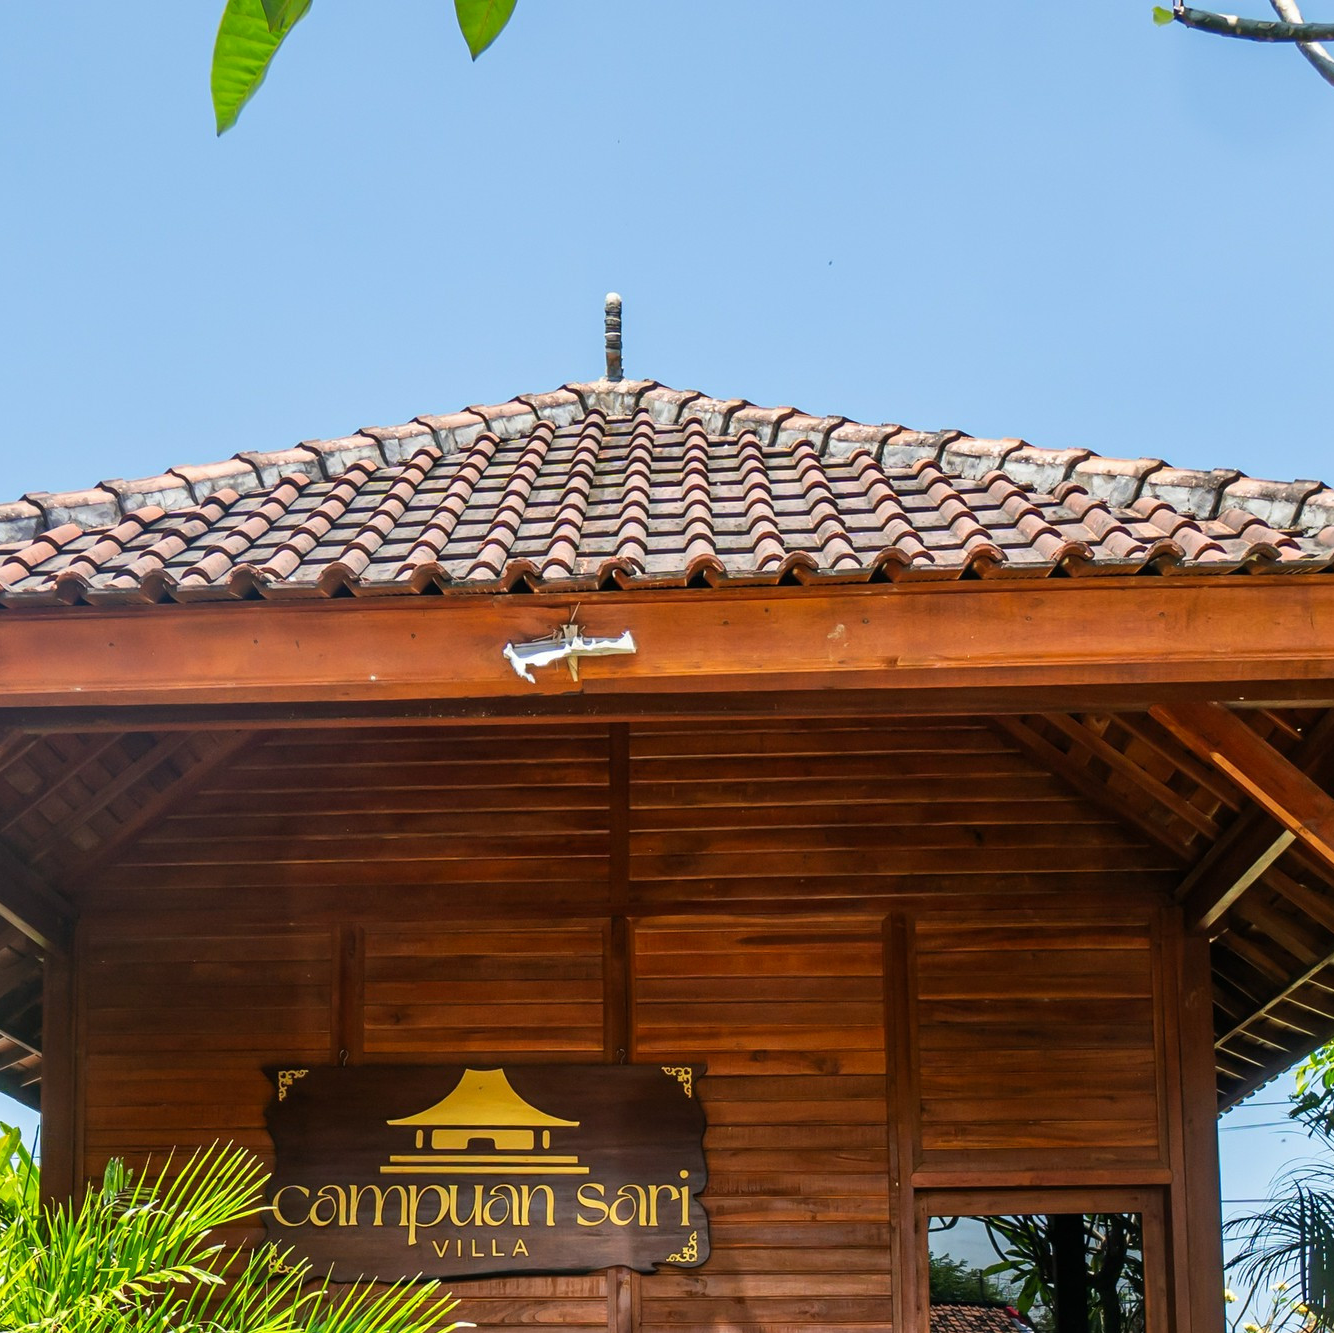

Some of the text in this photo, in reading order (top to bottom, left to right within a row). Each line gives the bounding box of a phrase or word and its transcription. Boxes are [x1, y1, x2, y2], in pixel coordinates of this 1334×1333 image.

[272, 1168, 691, 1246] campuan sari
[431, 1238, 530, 1258] VILLA
